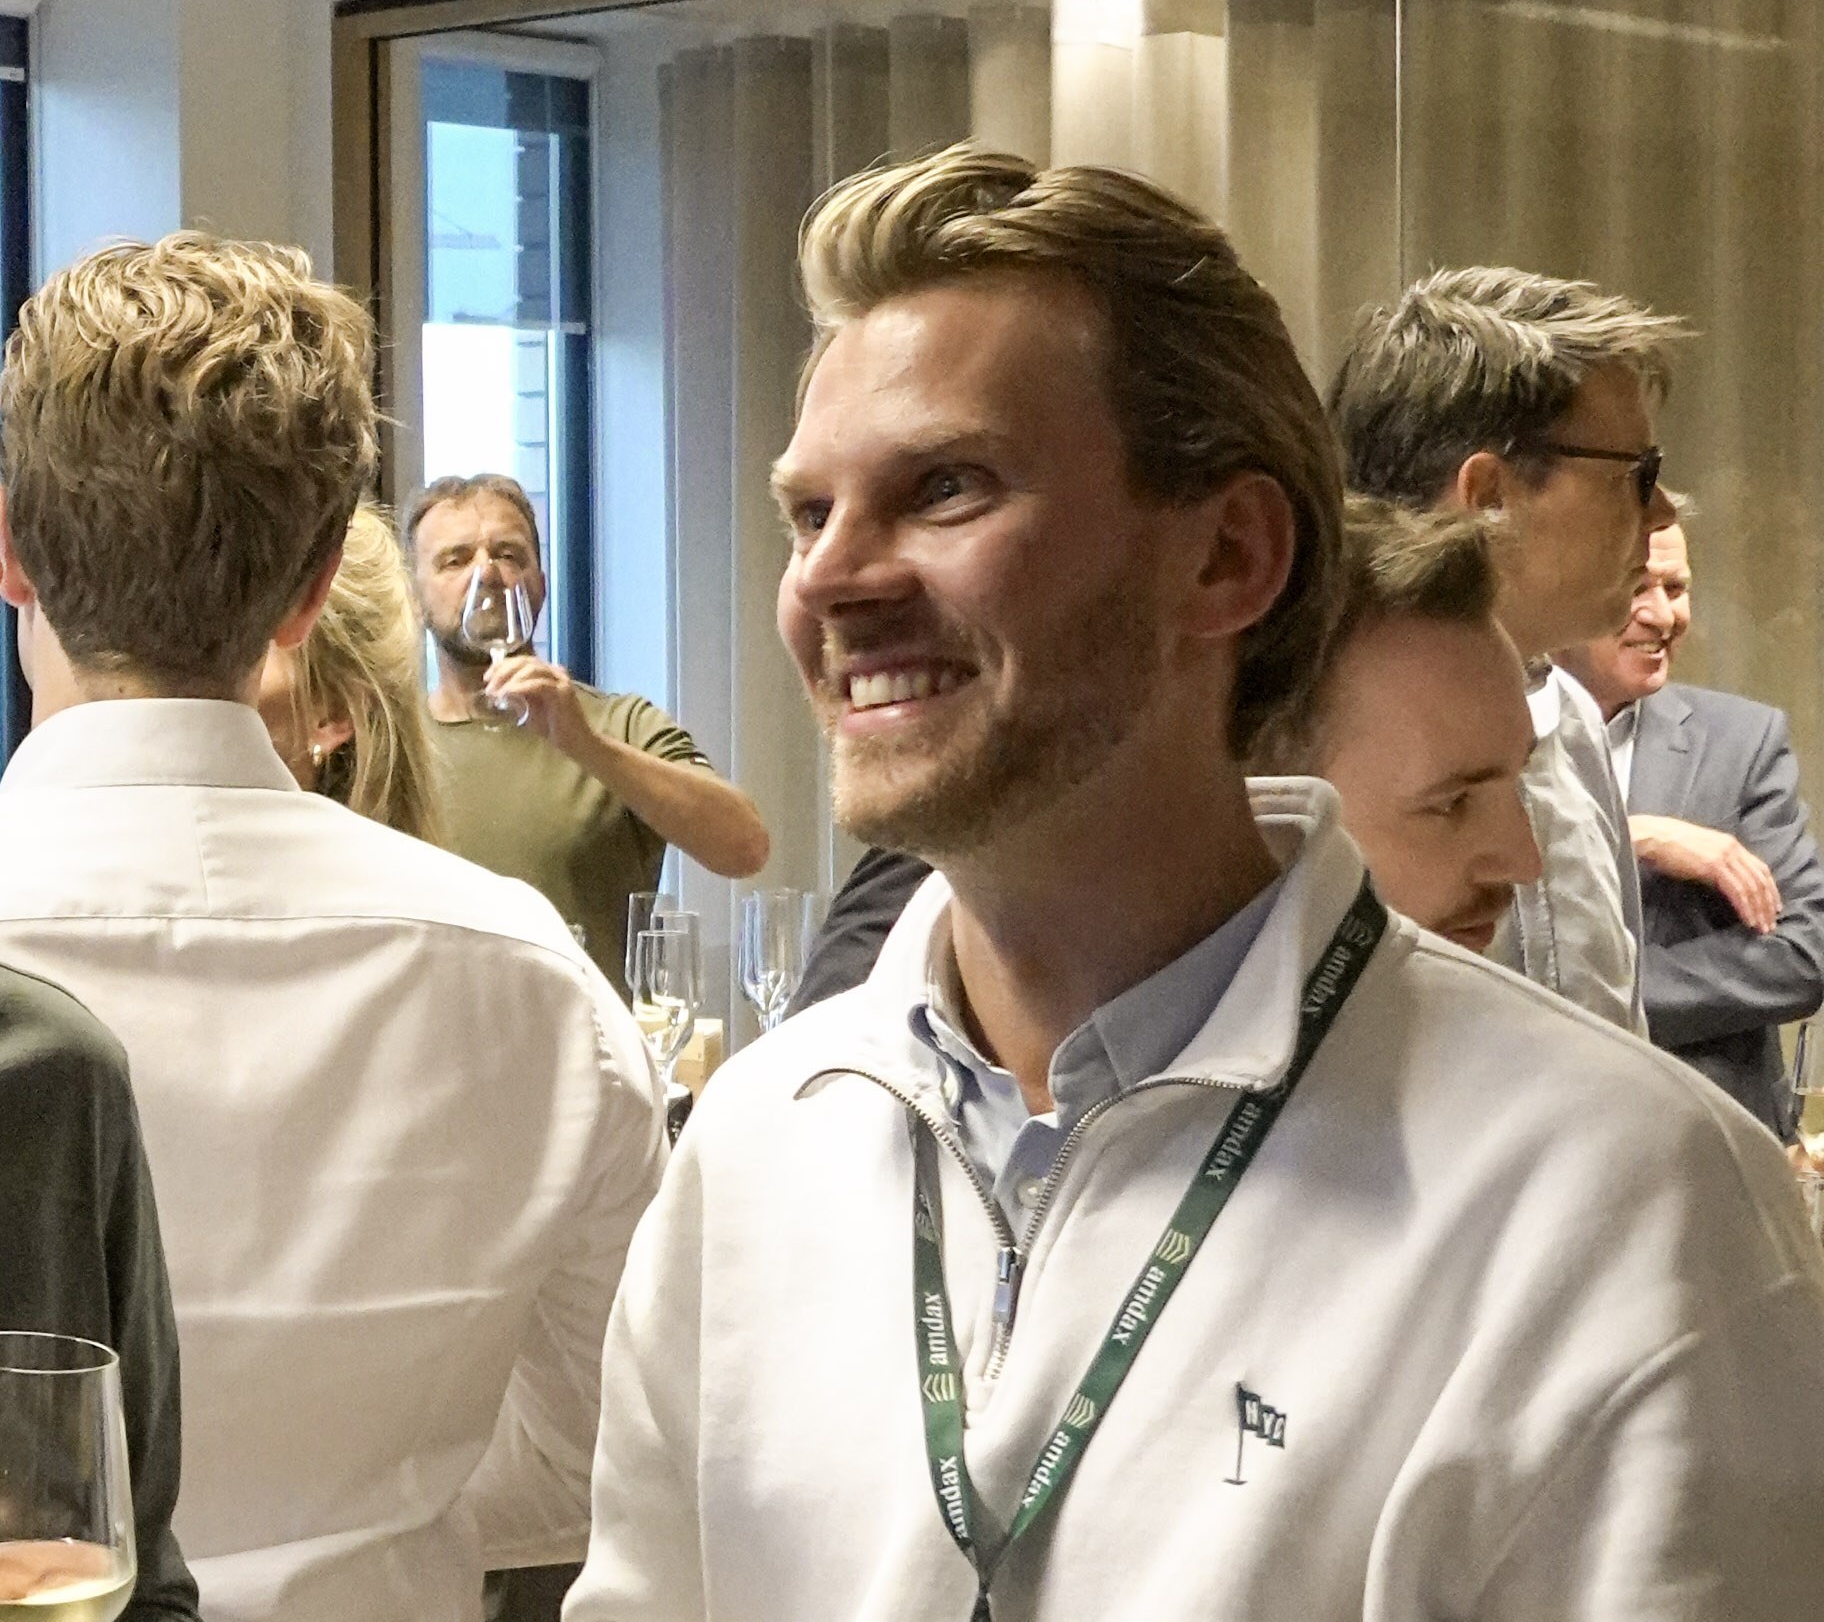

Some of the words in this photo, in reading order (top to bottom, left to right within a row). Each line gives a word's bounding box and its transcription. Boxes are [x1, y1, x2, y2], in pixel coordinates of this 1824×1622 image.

[1301, 945, 1351, 1019] amdax
[1205, 1102, 1261, 1181] amdax
[919, 1291, 949, 1366] amdax
[1112, 1266, 1166, 1346] amdax
[939, 1455, 969, 1539] amdax
[1023, 1432, 1072, 1508] amdax
